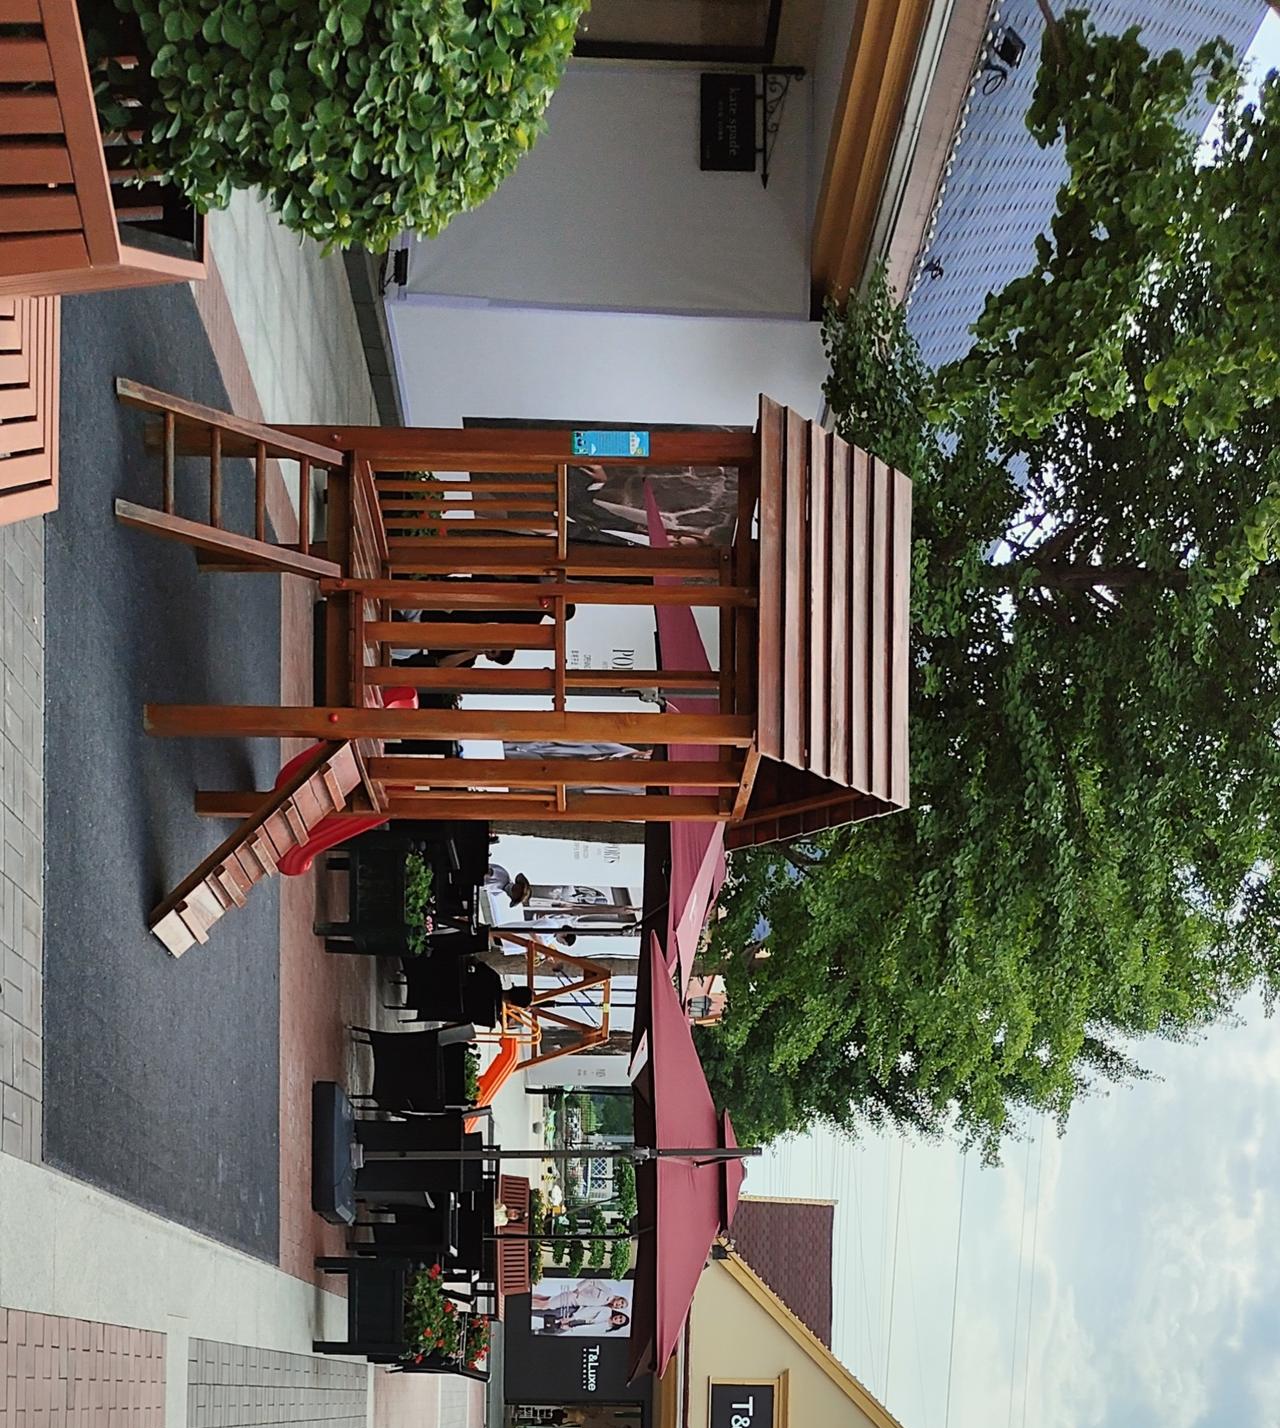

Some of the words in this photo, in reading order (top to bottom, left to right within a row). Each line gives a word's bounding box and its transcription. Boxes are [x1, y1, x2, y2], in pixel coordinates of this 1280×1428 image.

[729, 87, 741, 114] kate
[726, 117, 741, 157] spade
[588, 1345, 600, 1391] T&Luxe
